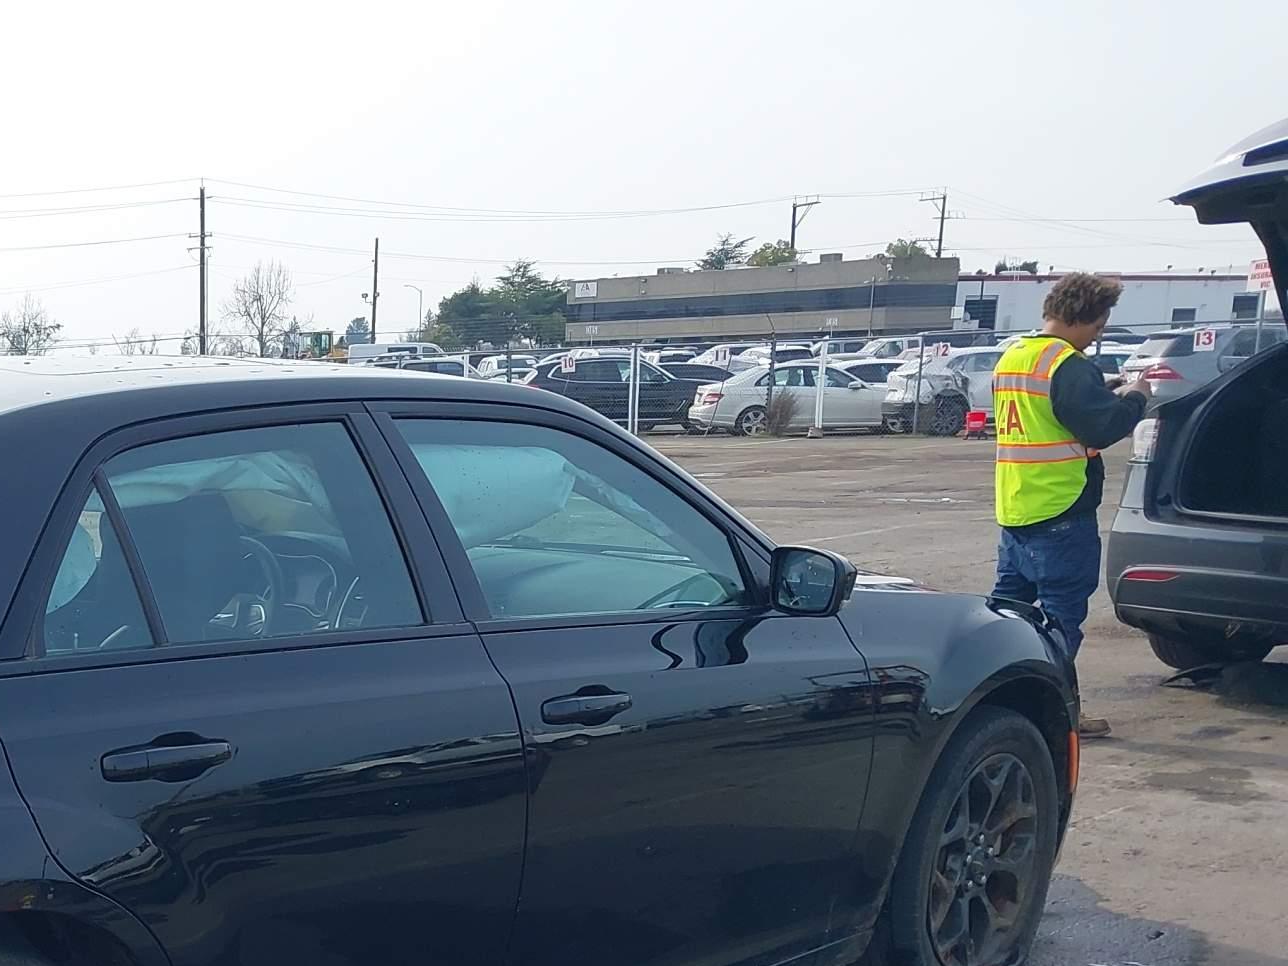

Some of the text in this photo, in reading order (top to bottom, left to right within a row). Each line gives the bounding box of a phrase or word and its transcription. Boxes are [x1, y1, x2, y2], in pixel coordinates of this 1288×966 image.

[1195, 331, 1213, 347] 13
[935, 344, 949, 357] 12
[563, 357, 574, 369] 10
